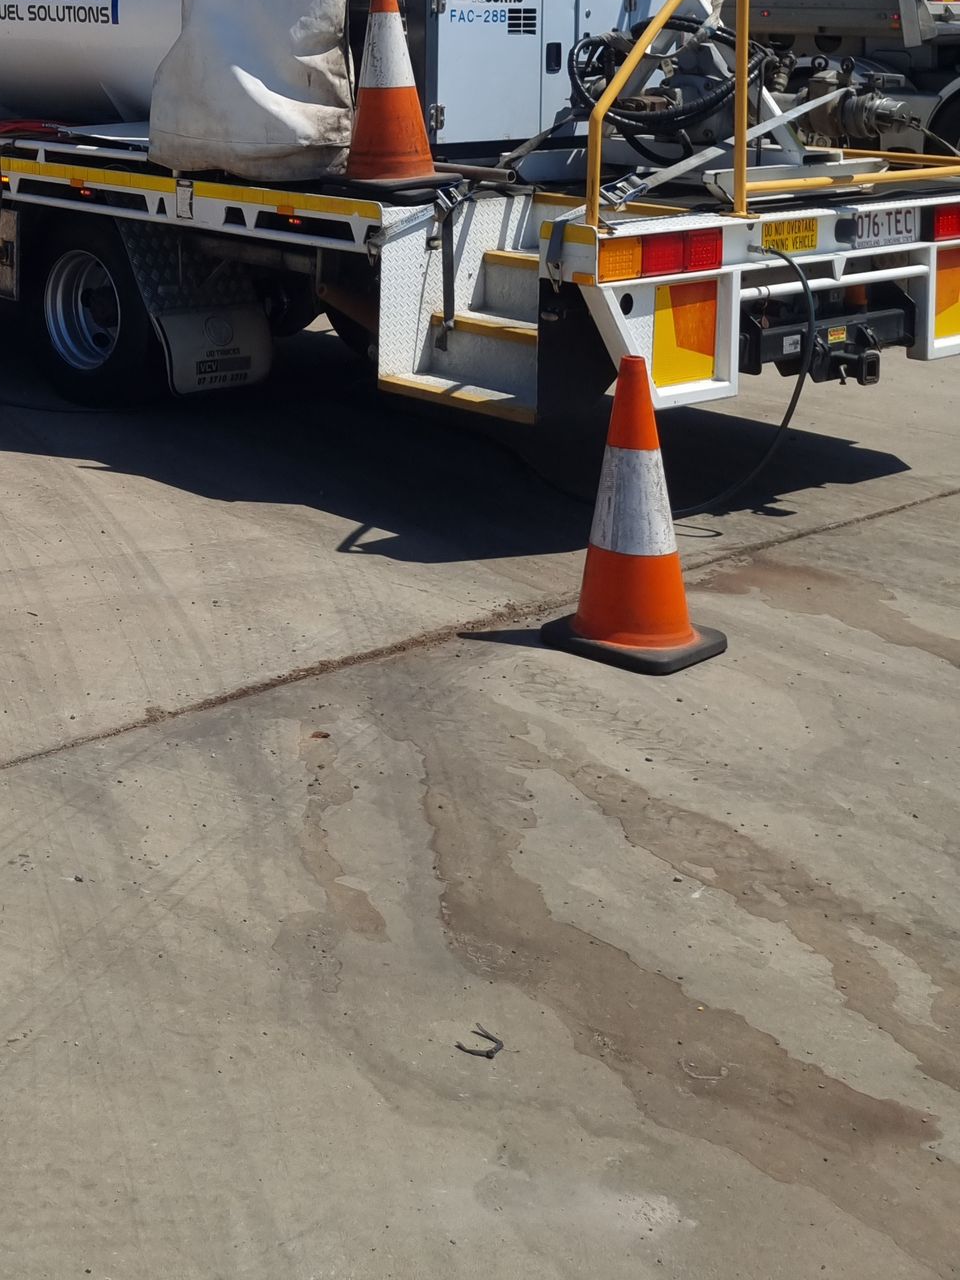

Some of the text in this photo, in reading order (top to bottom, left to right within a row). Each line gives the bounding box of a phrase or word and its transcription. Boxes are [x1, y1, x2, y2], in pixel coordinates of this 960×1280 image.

[27, 5, 110, 24] SOLUTIONS
[450, 9, 507, 23] FAC-28B
[764, 217, 815, 236] DO NOT OVERTAKE
[791, 234, 815, 249] VEHICLE
